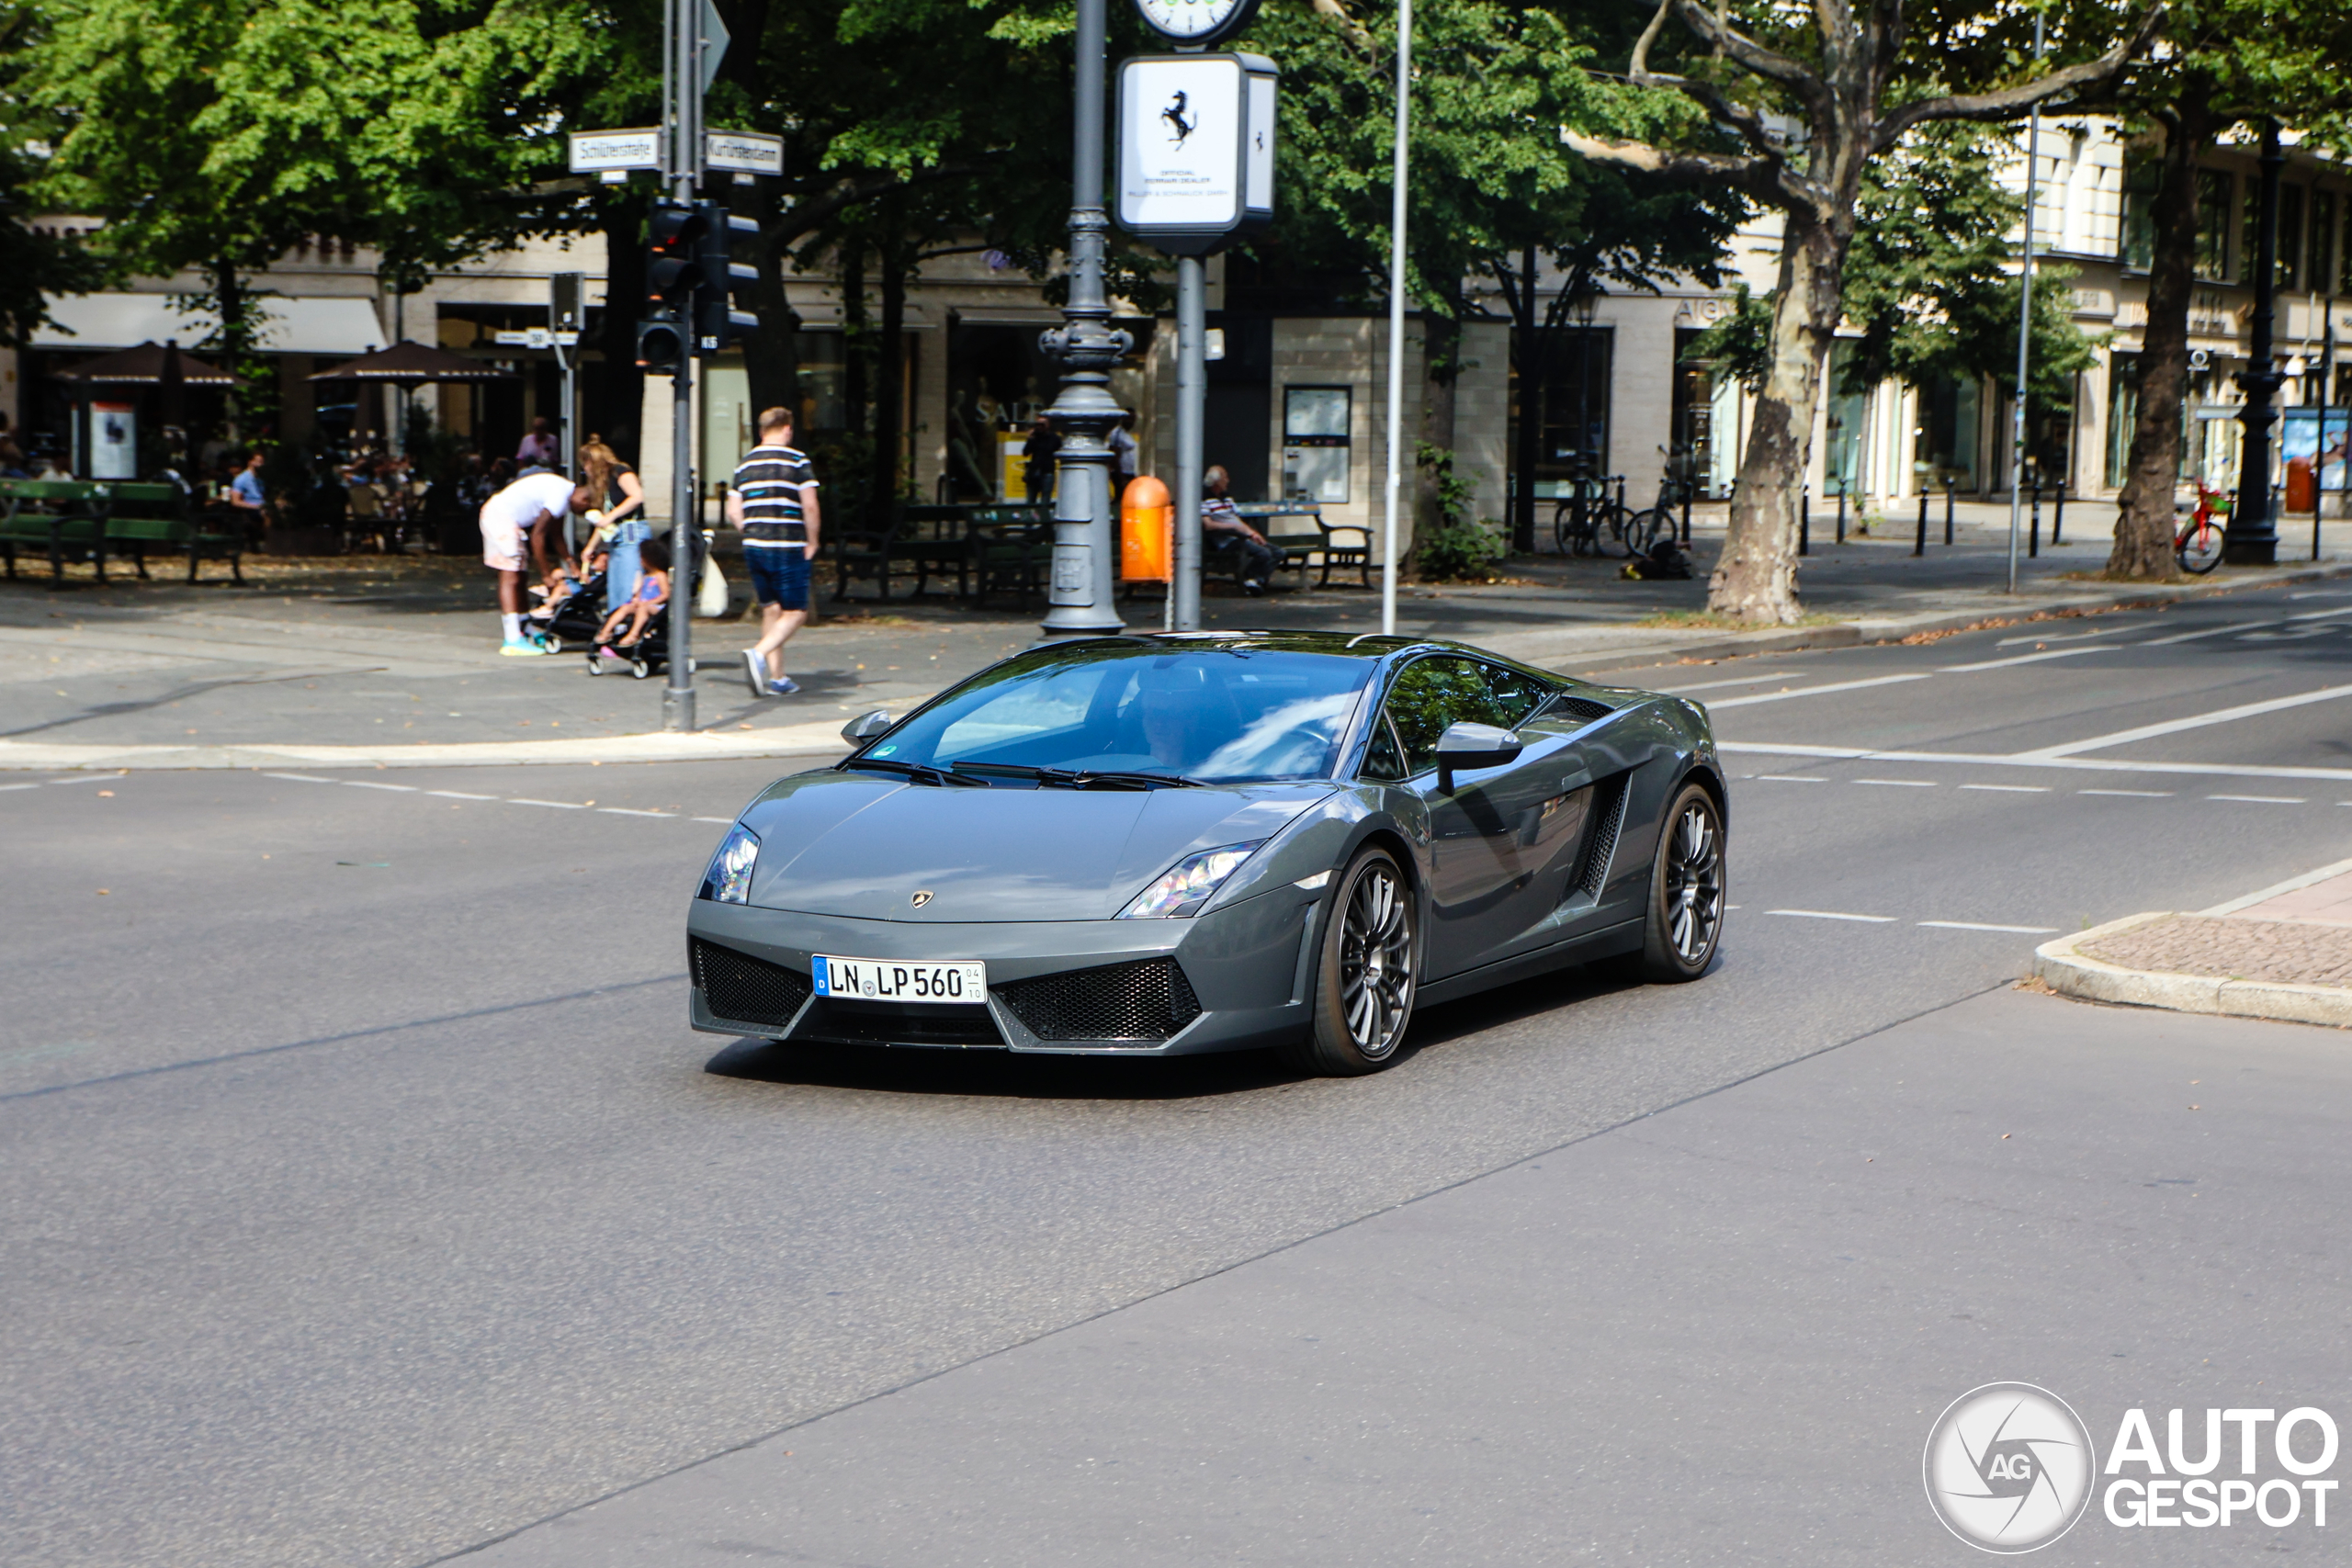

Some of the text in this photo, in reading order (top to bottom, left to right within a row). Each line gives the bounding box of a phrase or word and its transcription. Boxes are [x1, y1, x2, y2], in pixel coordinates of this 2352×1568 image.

[975, 401, 1045, 423] SALE
[966, 968, 979, 978] 04
[830, 963, 860, 994] LN
[818, 979, 826, 989] D
[968, 989, 981, 998] 10
